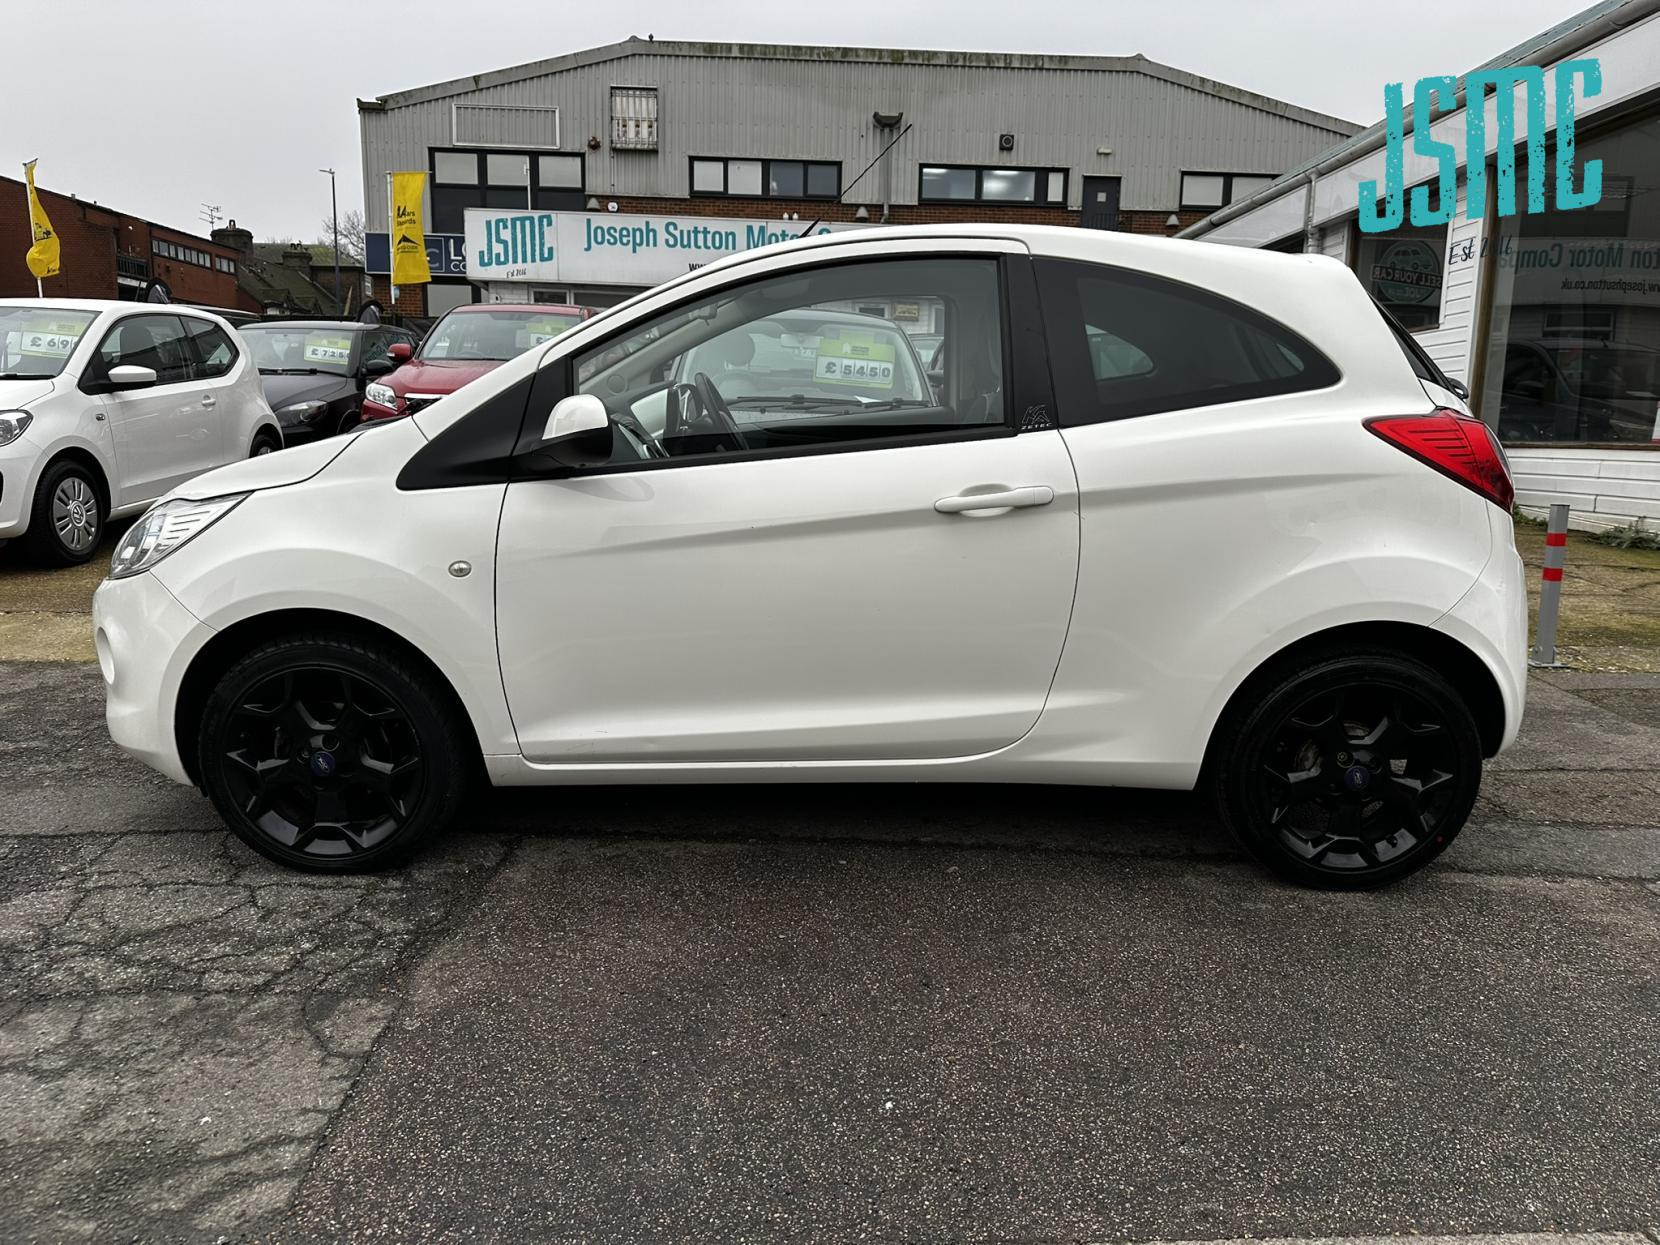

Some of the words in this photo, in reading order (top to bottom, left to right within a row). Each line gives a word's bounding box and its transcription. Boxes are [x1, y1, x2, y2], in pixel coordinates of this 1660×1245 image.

[479, 214, 554, 267] JSMC
[584, 218, 658, 253] Joseph
[664, 221, 736, 250] Sutton
